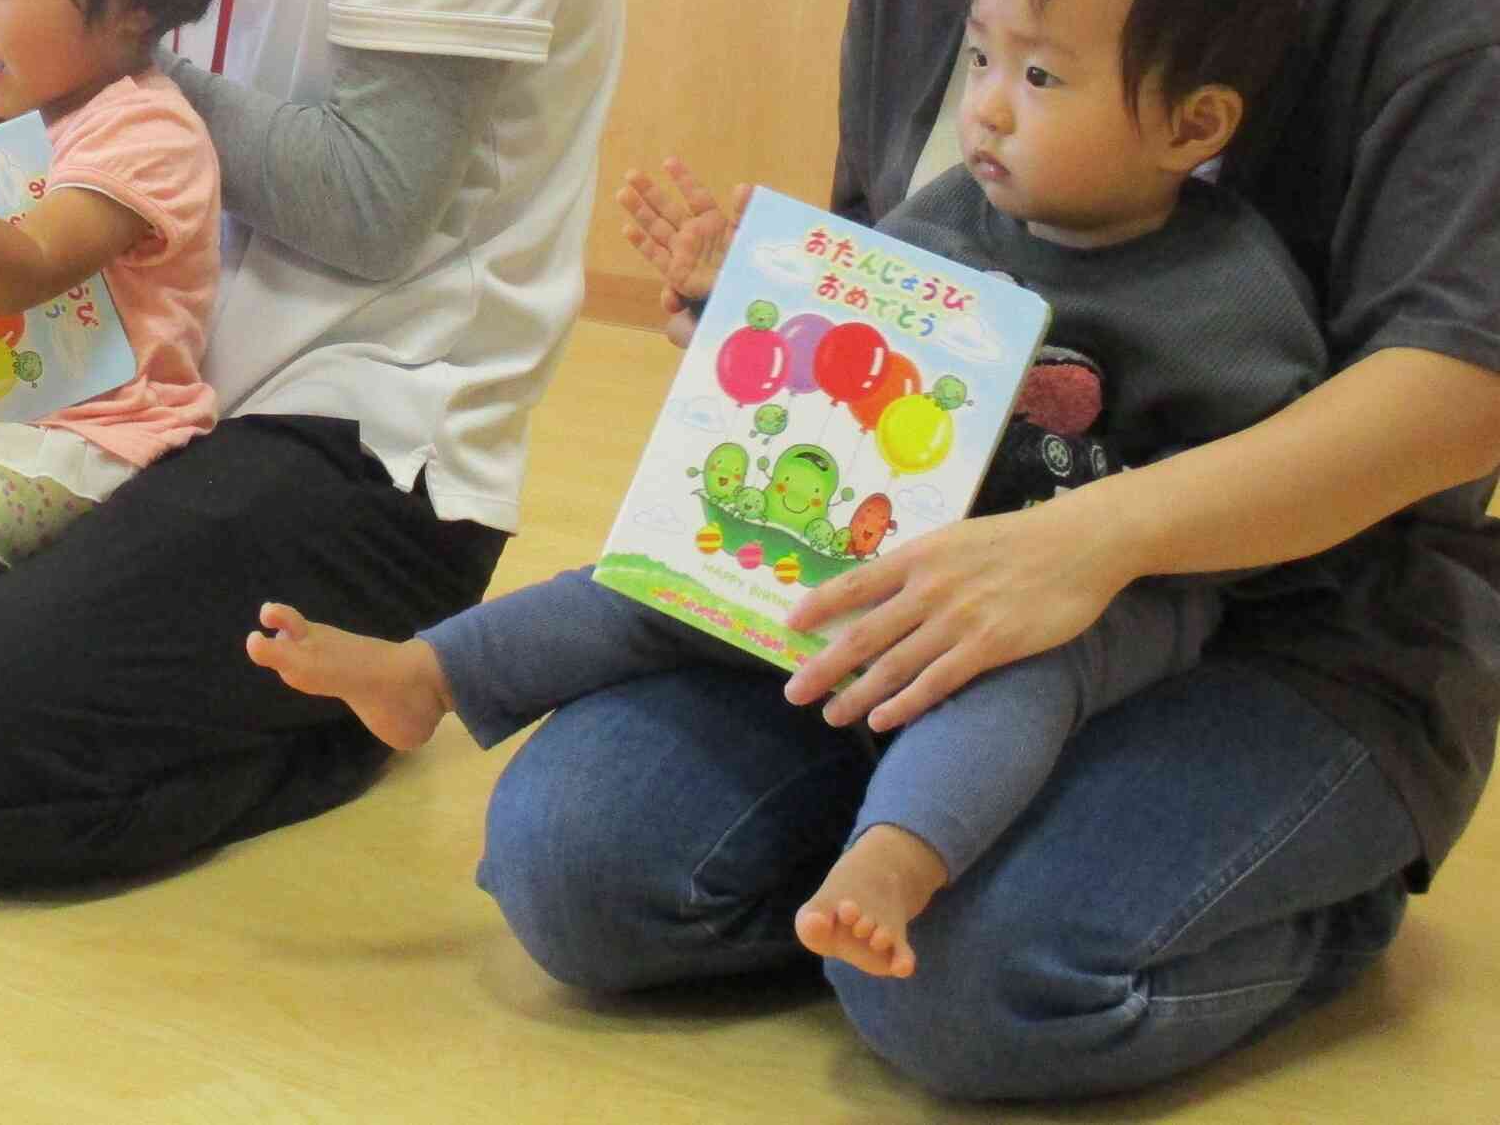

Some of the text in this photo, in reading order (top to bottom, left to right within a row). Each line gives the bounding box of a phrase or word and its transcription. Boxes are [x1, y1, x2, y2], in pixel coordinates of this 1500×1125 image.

[805, 227, 975, 312] おたんじょうび
[816, 272, 937, 337] おめでとう
